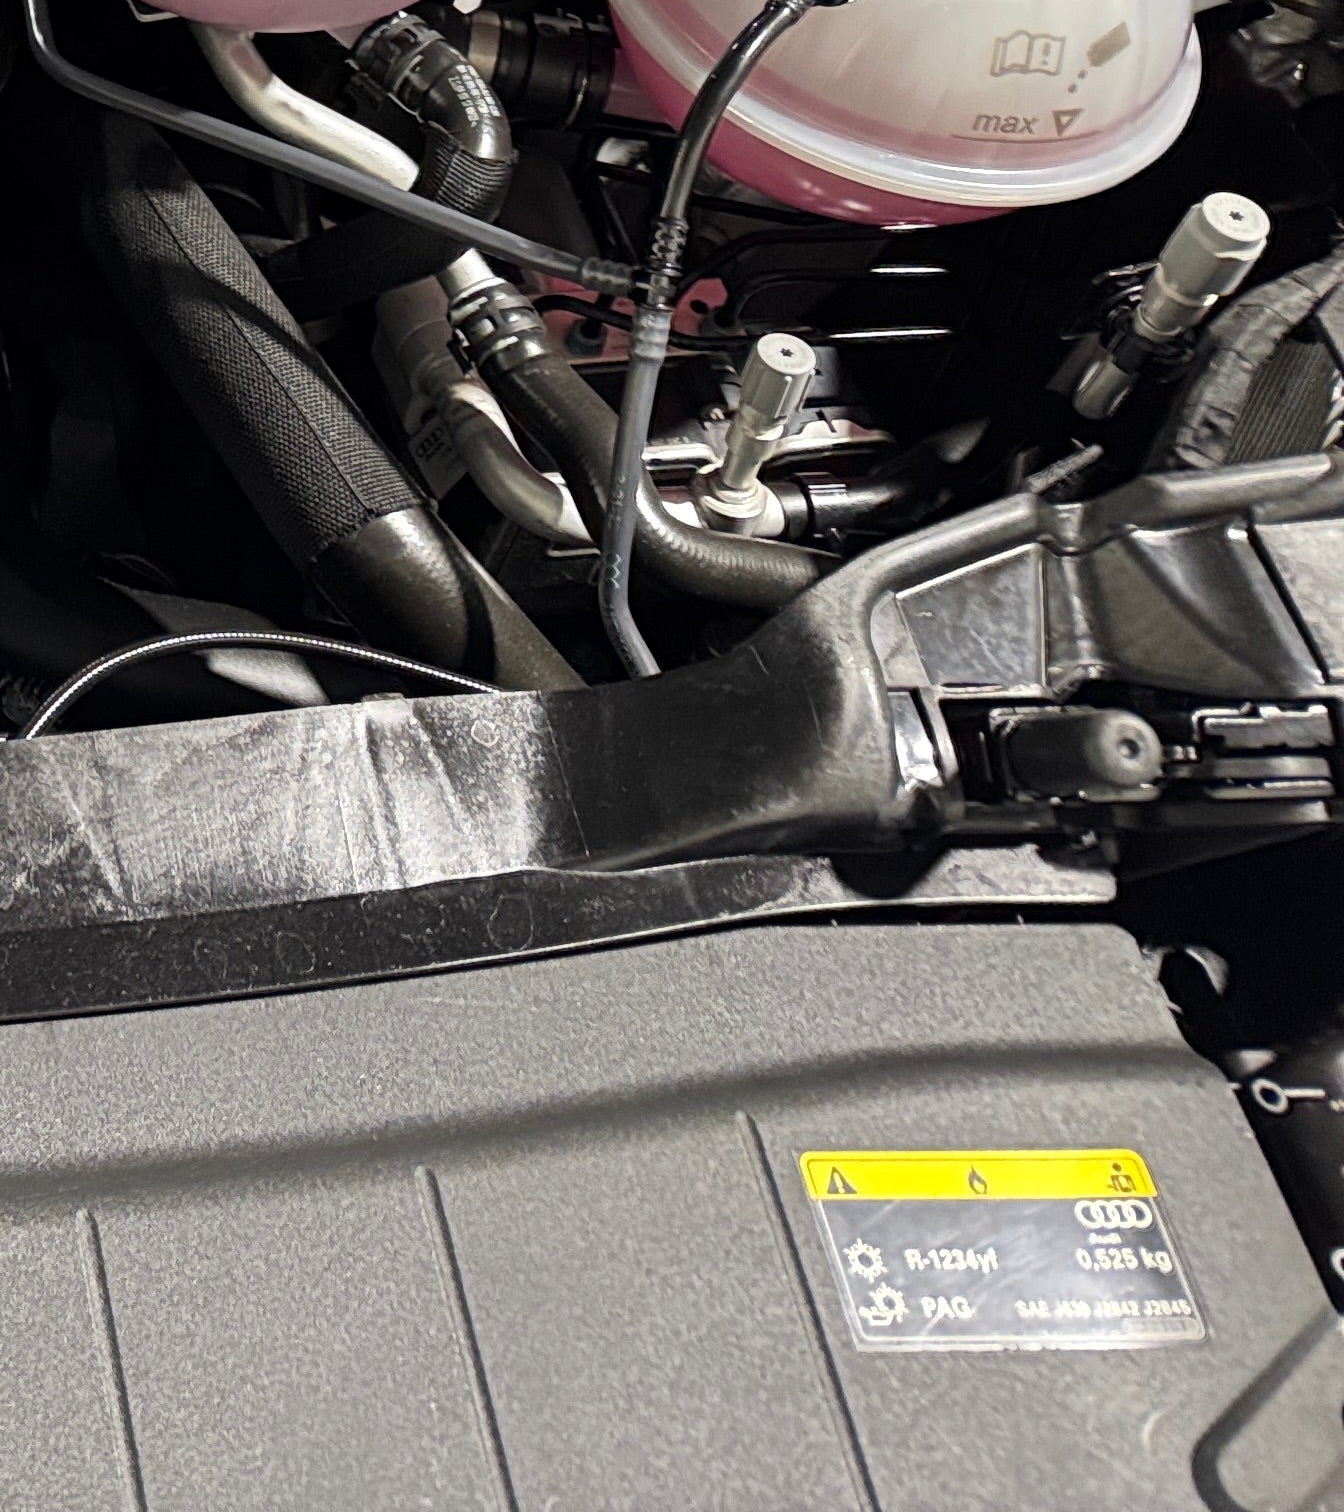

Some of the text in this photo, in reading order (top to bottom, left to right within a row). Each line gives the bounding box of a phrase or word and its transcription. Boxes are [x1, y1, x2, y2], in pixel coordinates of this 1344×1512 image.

[973, 114, 1040, 135] max
[1140, 1247, 1174, 1275] kg
[920, 1296, 975, 1320] PAG
[1015, 1299, 1052, 1318] SAE
